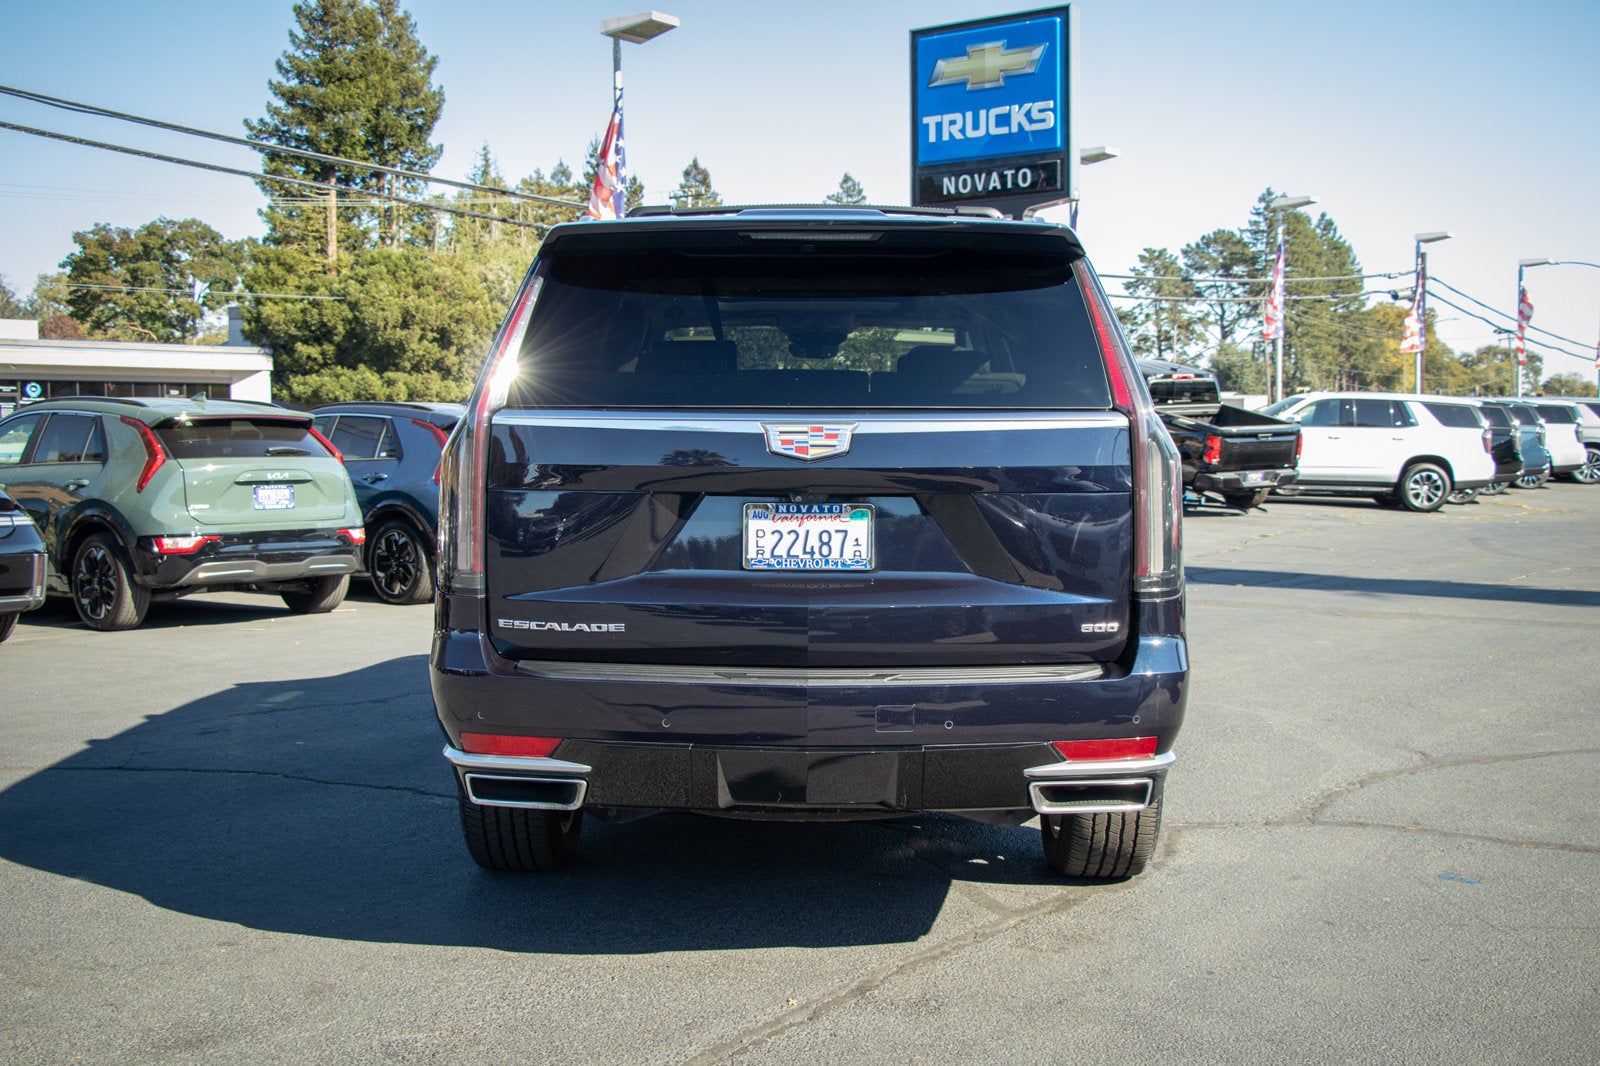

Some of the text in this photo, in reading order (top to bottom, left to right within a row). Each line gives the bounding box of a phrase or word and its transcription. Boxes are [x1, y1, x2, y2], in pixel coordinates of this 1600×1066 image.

[922, 100, 1055, 143] TRUCKS
[943, 168, 1032, 195] NOVATO
[752, 510, 768, 519] AUG
[778, 504, 840, 513] NOVATO
[772, 513, 849, 527] California
[770, 529, 848, 559] 22487
[774, 559, 843, 568] CHEVROLET
[498, 619, 625, 632] ESCALADE
[1081, 622, 1119, 632] 600
